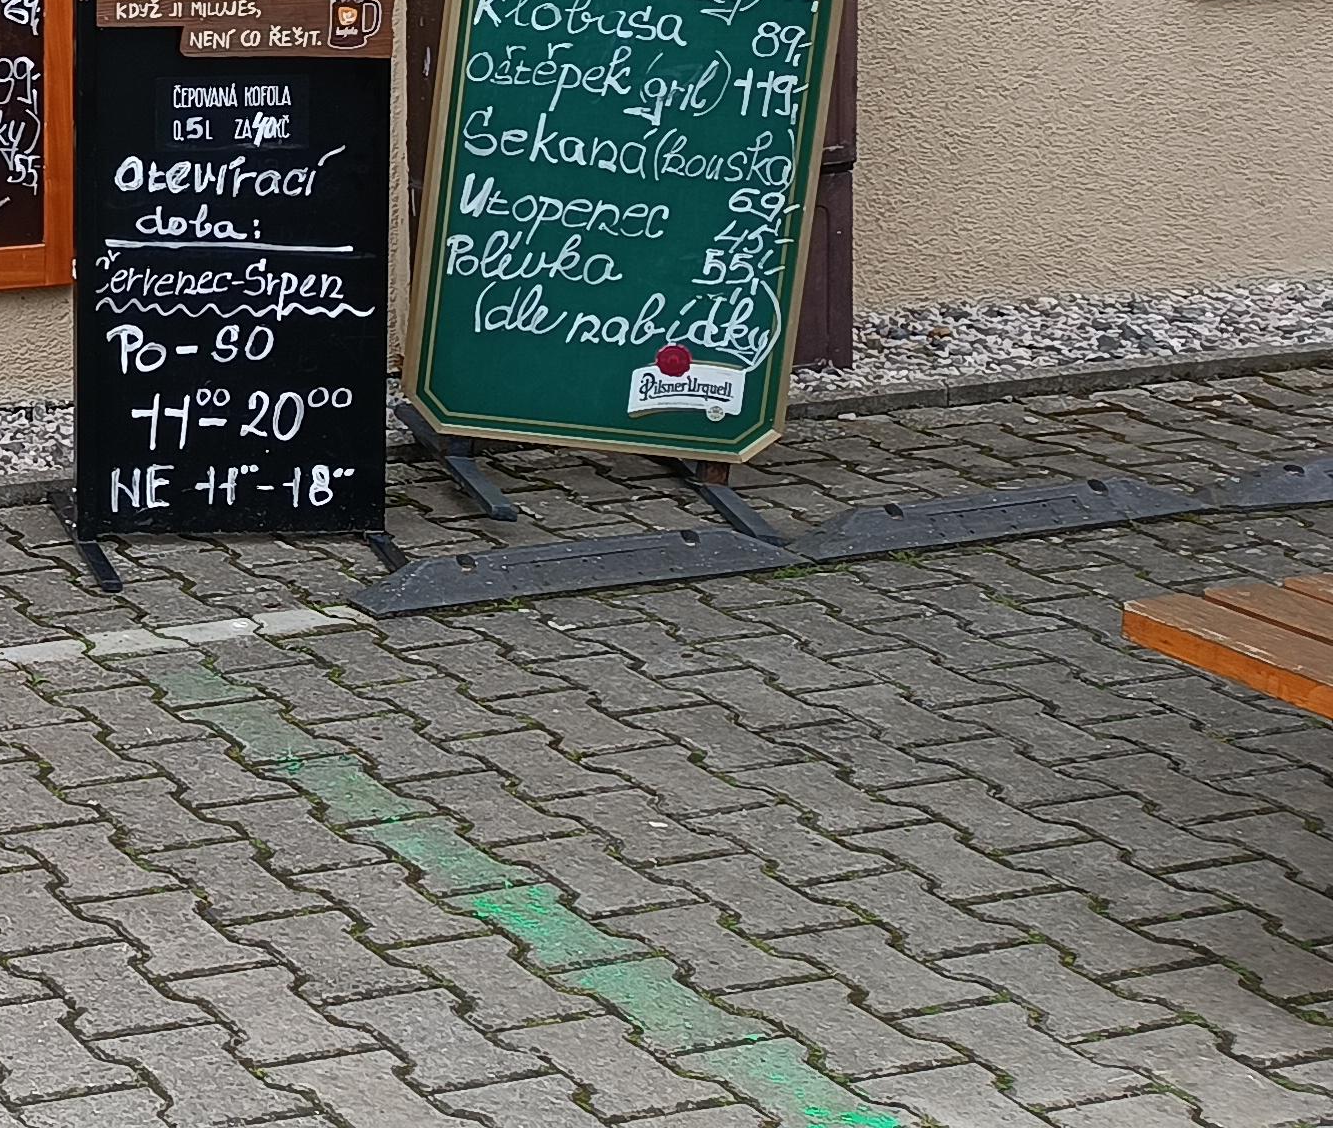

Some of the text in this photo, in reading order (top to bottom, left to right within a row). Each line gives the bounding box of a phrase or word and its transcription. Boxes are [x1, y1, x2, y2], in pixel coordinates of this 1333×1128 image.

[168, 2, 183, 18] JI
[189, 25, 323, 50] NENÍ CO ŘEŠIT.
[173, 82, 292, 108] ČEPOVANÁ KOFOLA
[114, 144, 345, 198] Otevírací
[135, 203, 262, 240] doba:
[459, 173, 671, 245] Utopenec
[638, 372, 733, 402] Pilsner Urquell
[110, 464, 175, 513] NE
